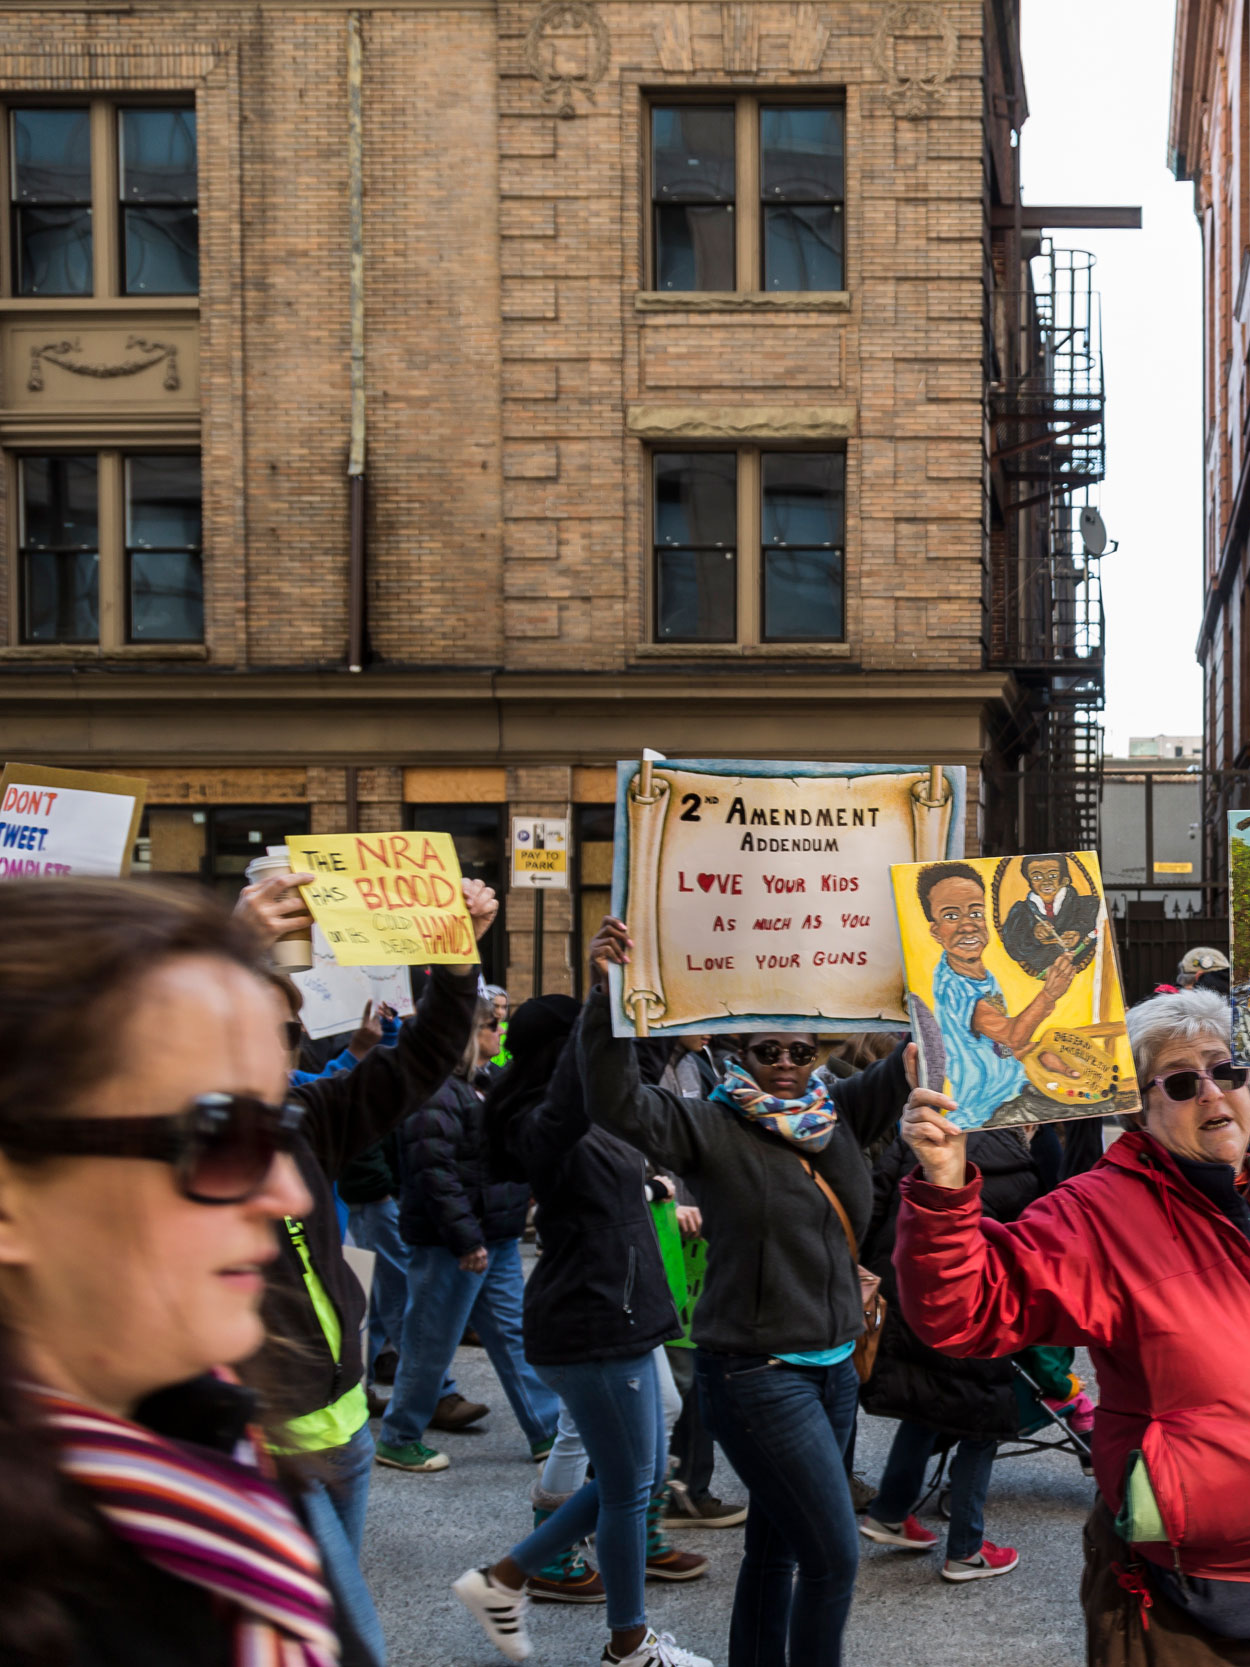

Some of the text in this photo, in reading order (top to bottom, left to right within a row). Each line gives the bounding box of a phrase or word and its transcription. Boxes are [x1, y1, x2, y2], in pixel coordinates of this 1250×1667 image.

[3, 787, 58, 816] DON'T
[726, 797, 879, 826] AMENDMENT
[740, 832, 839, 852] ADDENDUM
[301, 836, 446, 872] THE NRA
[521, 851, 559, 860] PAY TO
[525, 861, 555, 870] PARK
[307, 873, 456, 911] HAS BLOOD
[763, 874, 806, 893] YOUR
[753, 917, 792, 931] MUCH
[801, 914, 823, 930] AS
[841, 913, 870, 928] YOU
[411, 914, 474, 956] HANDS
[686, 951, 868, 972] LOVE YOUR GUNS
